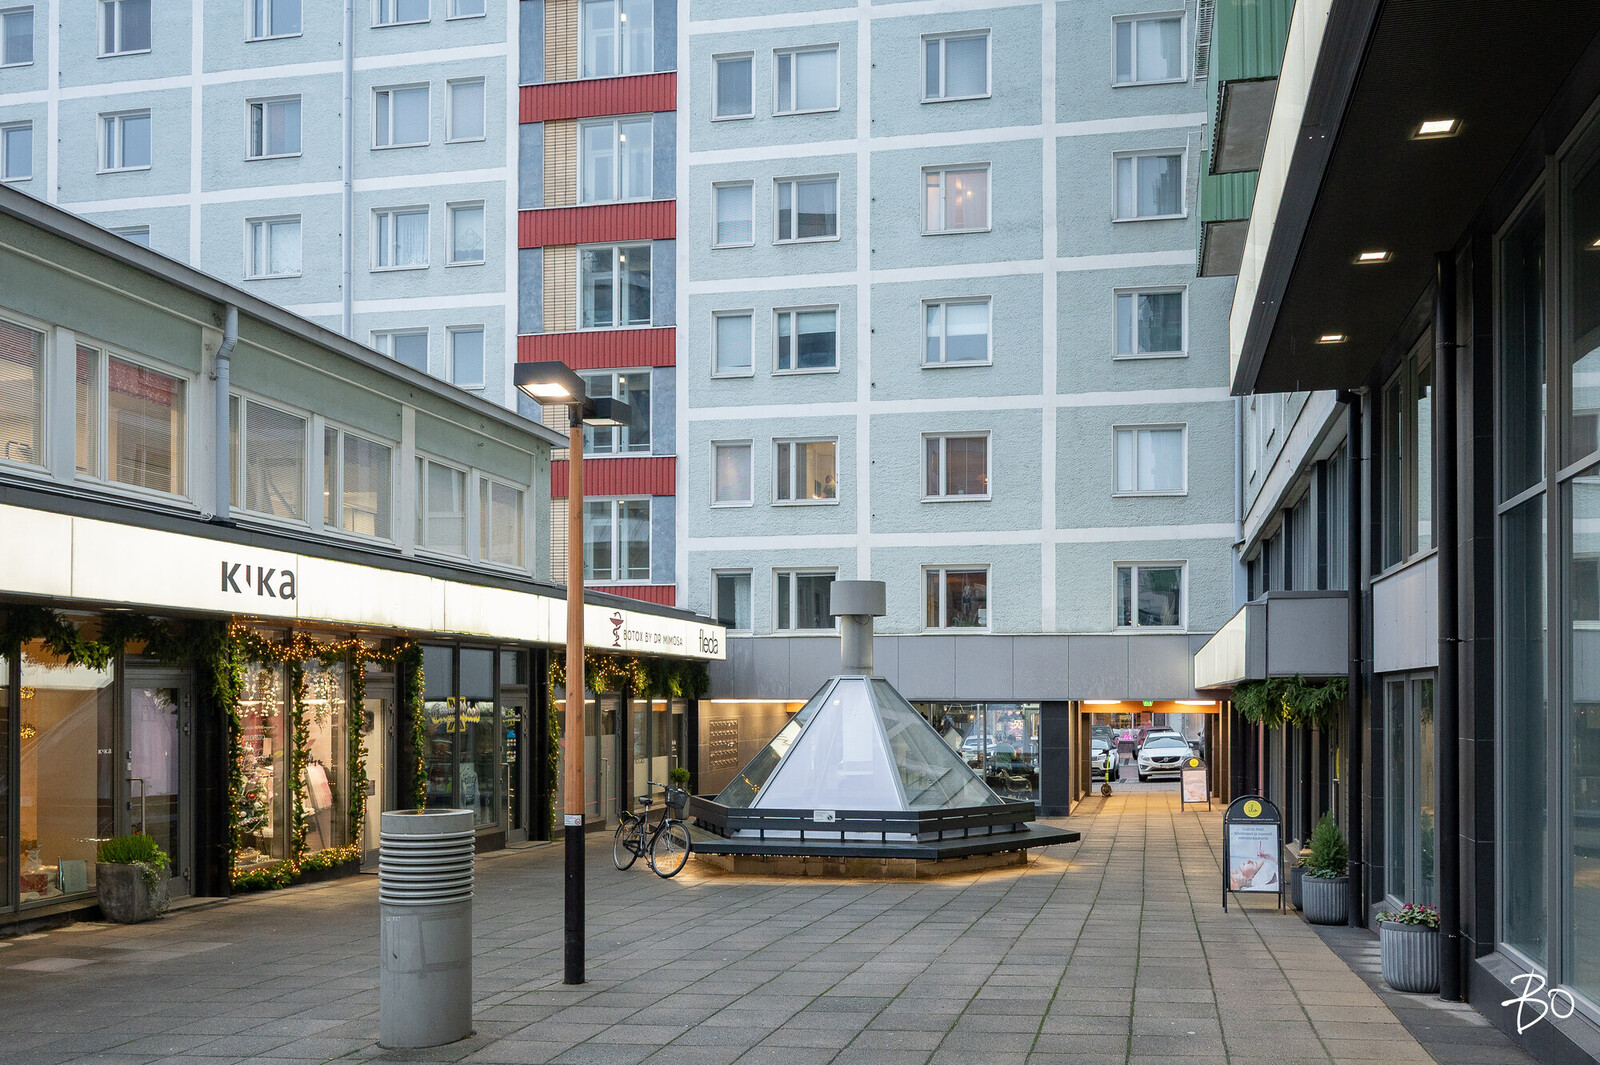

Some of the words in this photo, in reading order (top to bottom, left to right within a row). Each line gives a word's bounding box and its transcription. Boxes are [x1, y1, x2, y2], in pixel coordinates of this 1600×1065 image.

[623, 629, 643, 642] BOTOX
[645, 632, 652, 643] BY
[654, 633, 661, 644] DR
[663, 635, 683, 646] MIMOSA
[699, 629, 718, 654] fleda
